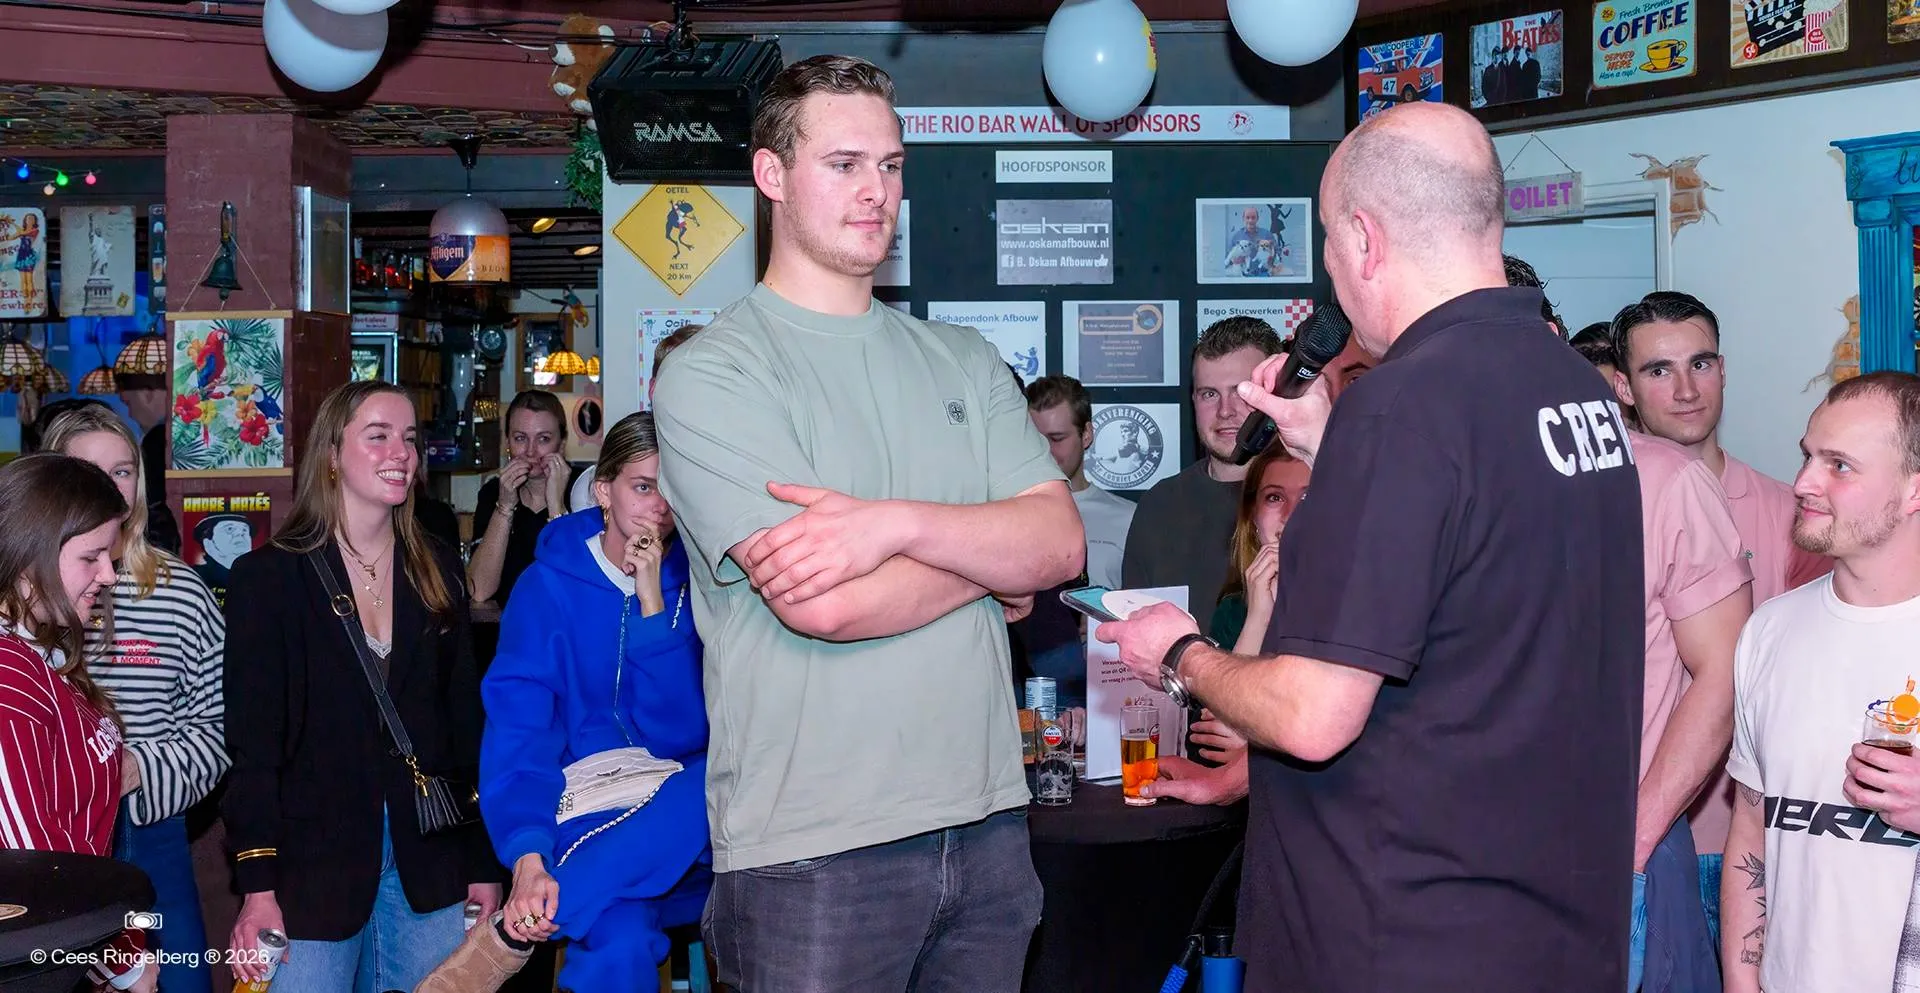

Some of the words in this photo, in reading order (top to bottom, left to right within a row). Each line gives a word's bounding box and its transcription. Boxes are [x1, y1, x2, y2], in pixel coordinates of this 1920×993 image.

[1598, 1, 1690, 50] COFFEE
[1388, 40, 1415, 51] COOPER
[1383, 81, 1396, 93] 47
[904, 115, 937, 133] THE
[942, 115, 974, 133] RIO
[979, 115, 1016, 133] BAR
[1020, 114, 1071, 133] WALL
[1076, 114, 1096, 133] OF
[1102, 114, 1201, 133] SPONSORS
[633, 122, 722, 142] RAMSA
[1001, 161, 1106, 173] HOOFDSPONSOR
[1000, 216, 1109, 234] oskam
[1000, 237, 1110, 249] www.oskamafbouw.nl
[1060, 255, 1097, 267] Afbouw
[1203, 307, 1227, 317] Bego
[1229, 307, 1284, 316] Stucwerken
[935, 313, 1000, 324] Schapendonk
[1002, 313, 1039, 323] Afbouw
[184, 496, 225, 513] ANDRE
[125, 648, 149, 656] JUST
[120, 656, 161, 665] MOMENT
